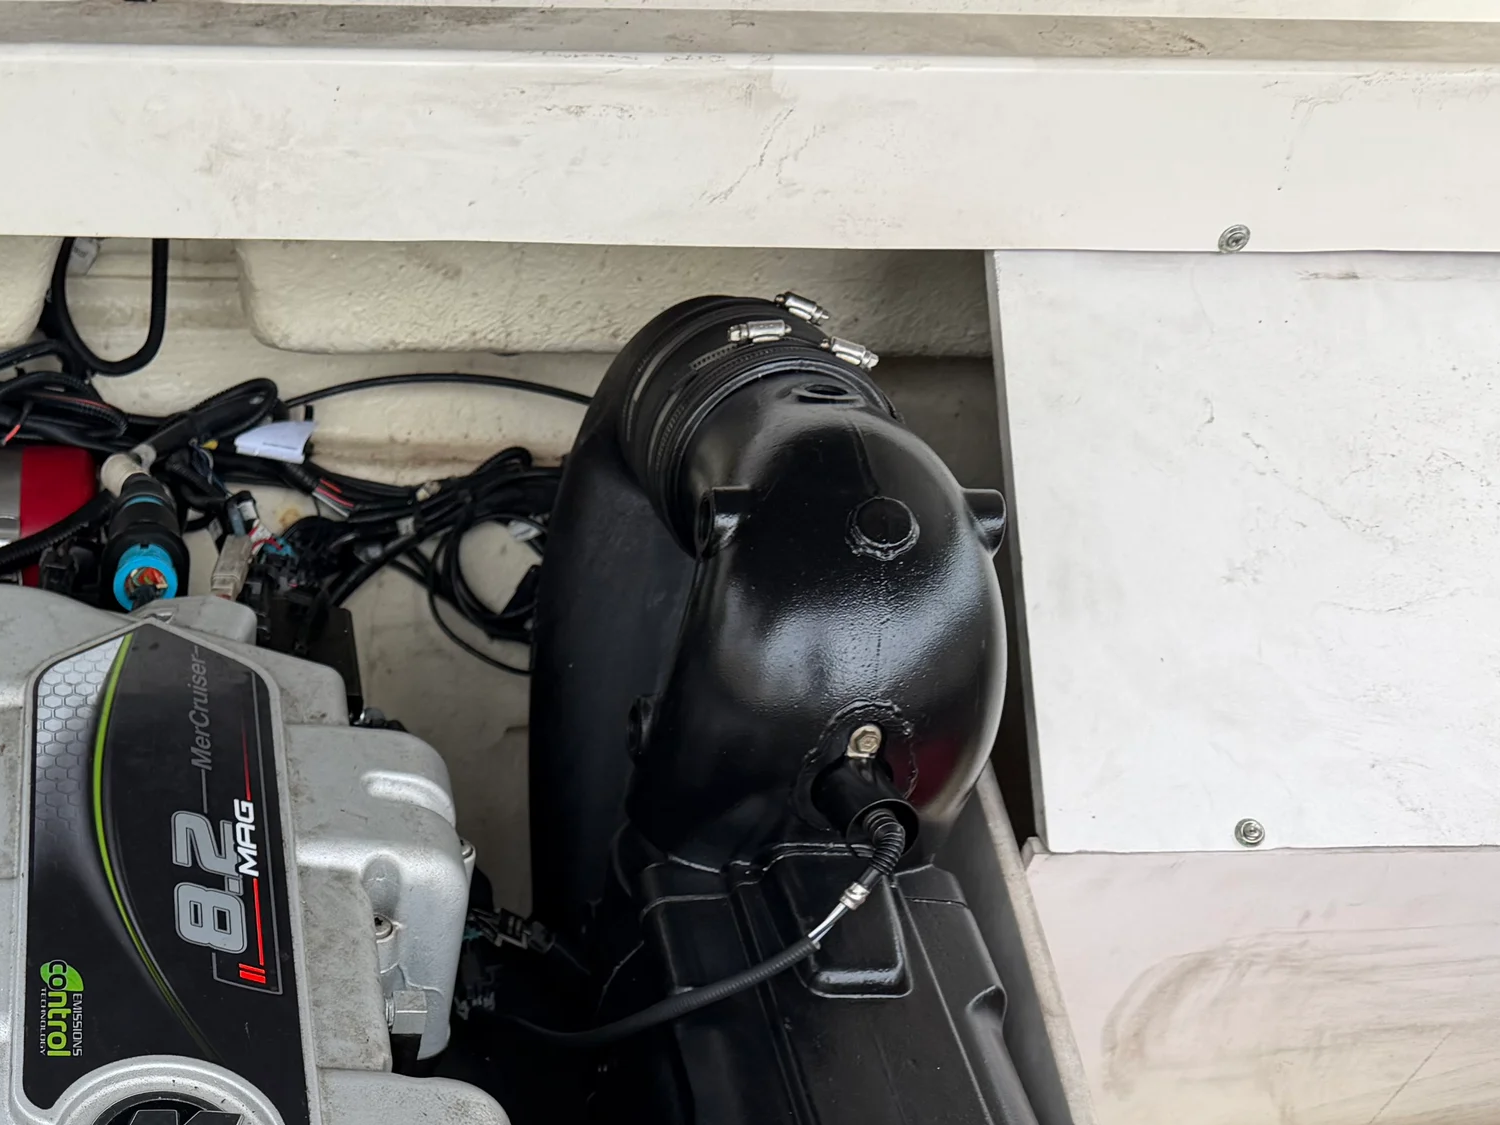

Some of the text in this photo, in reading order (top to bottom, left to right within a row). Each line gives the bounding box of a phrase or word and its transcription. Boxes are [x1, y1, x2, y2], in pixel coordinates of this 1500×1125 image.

[191, 657, 211, 771] MerCruiser
[171, 811, 247, 954] 8.2
[233, 798, 259, 877] MAG
[47, 960, 71, 1056] control
[72, 993, 83, 1056] EMISSIONS
